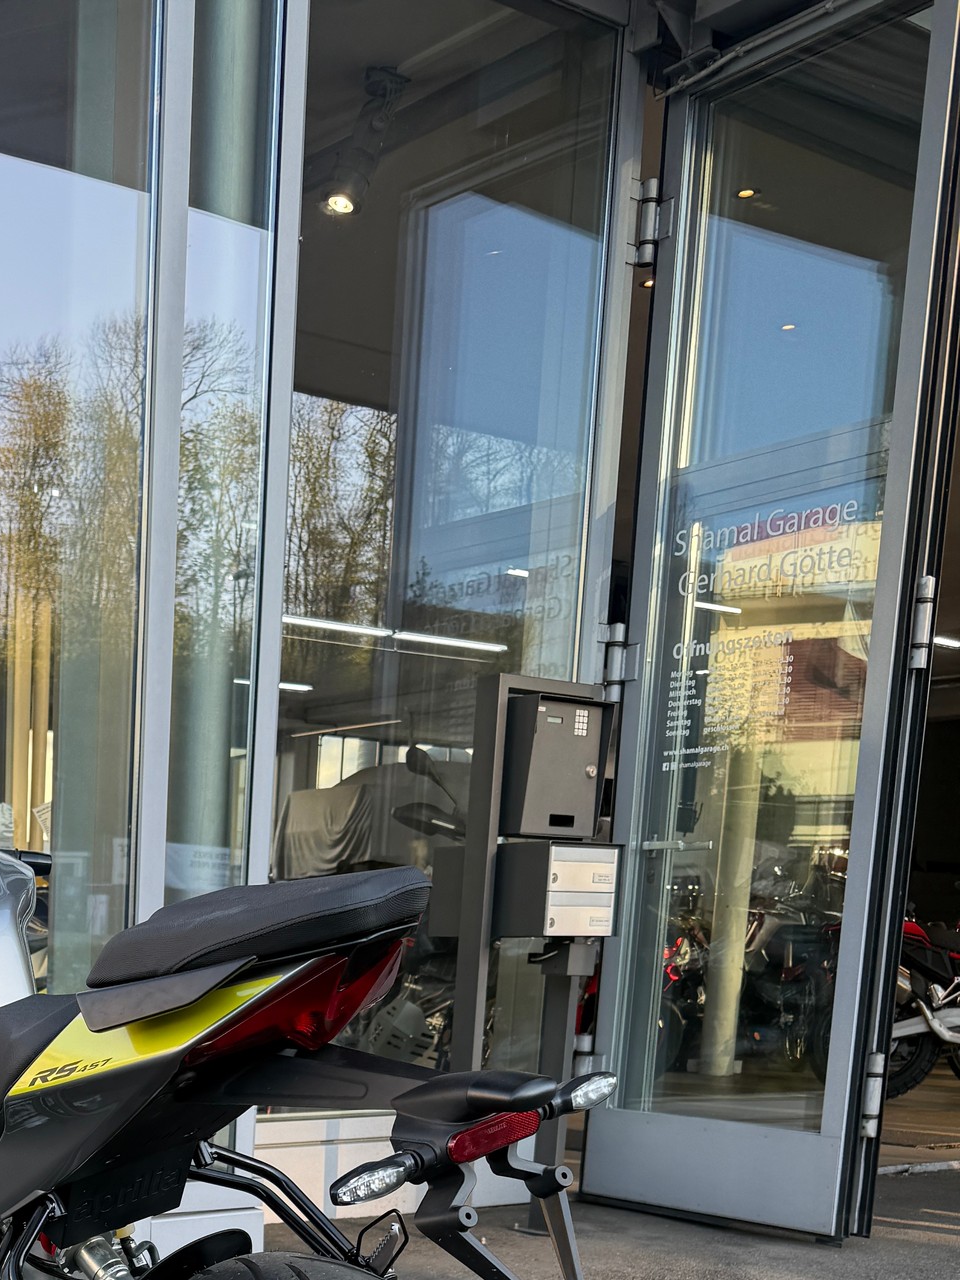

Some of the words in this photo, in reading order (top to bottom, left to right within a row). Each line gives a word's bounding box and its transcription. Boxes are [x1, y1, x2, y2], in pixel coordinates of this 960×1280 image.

[766, 499, 858, 533] Garage
[779, 545, 853, 580] Götte
[670, 670, 693, 678] Monag
[669, 680, 696, 688] Dietag
[669, 688, 696, 698] Mittoch
[668, 699, 702, 708] Donerstag
[667, 710, 688, 718] Freiag
[666, 719, 692, 728] Samtag
[665, 729, 690, 737] Sontag
[663, 744, 730, 757] wwwshamalgarage.ch
[28, 1059, 84, 1088] RS
[76, 1057, 113, 1074] 457
[72, 1168, 182, 1224] aprilia
